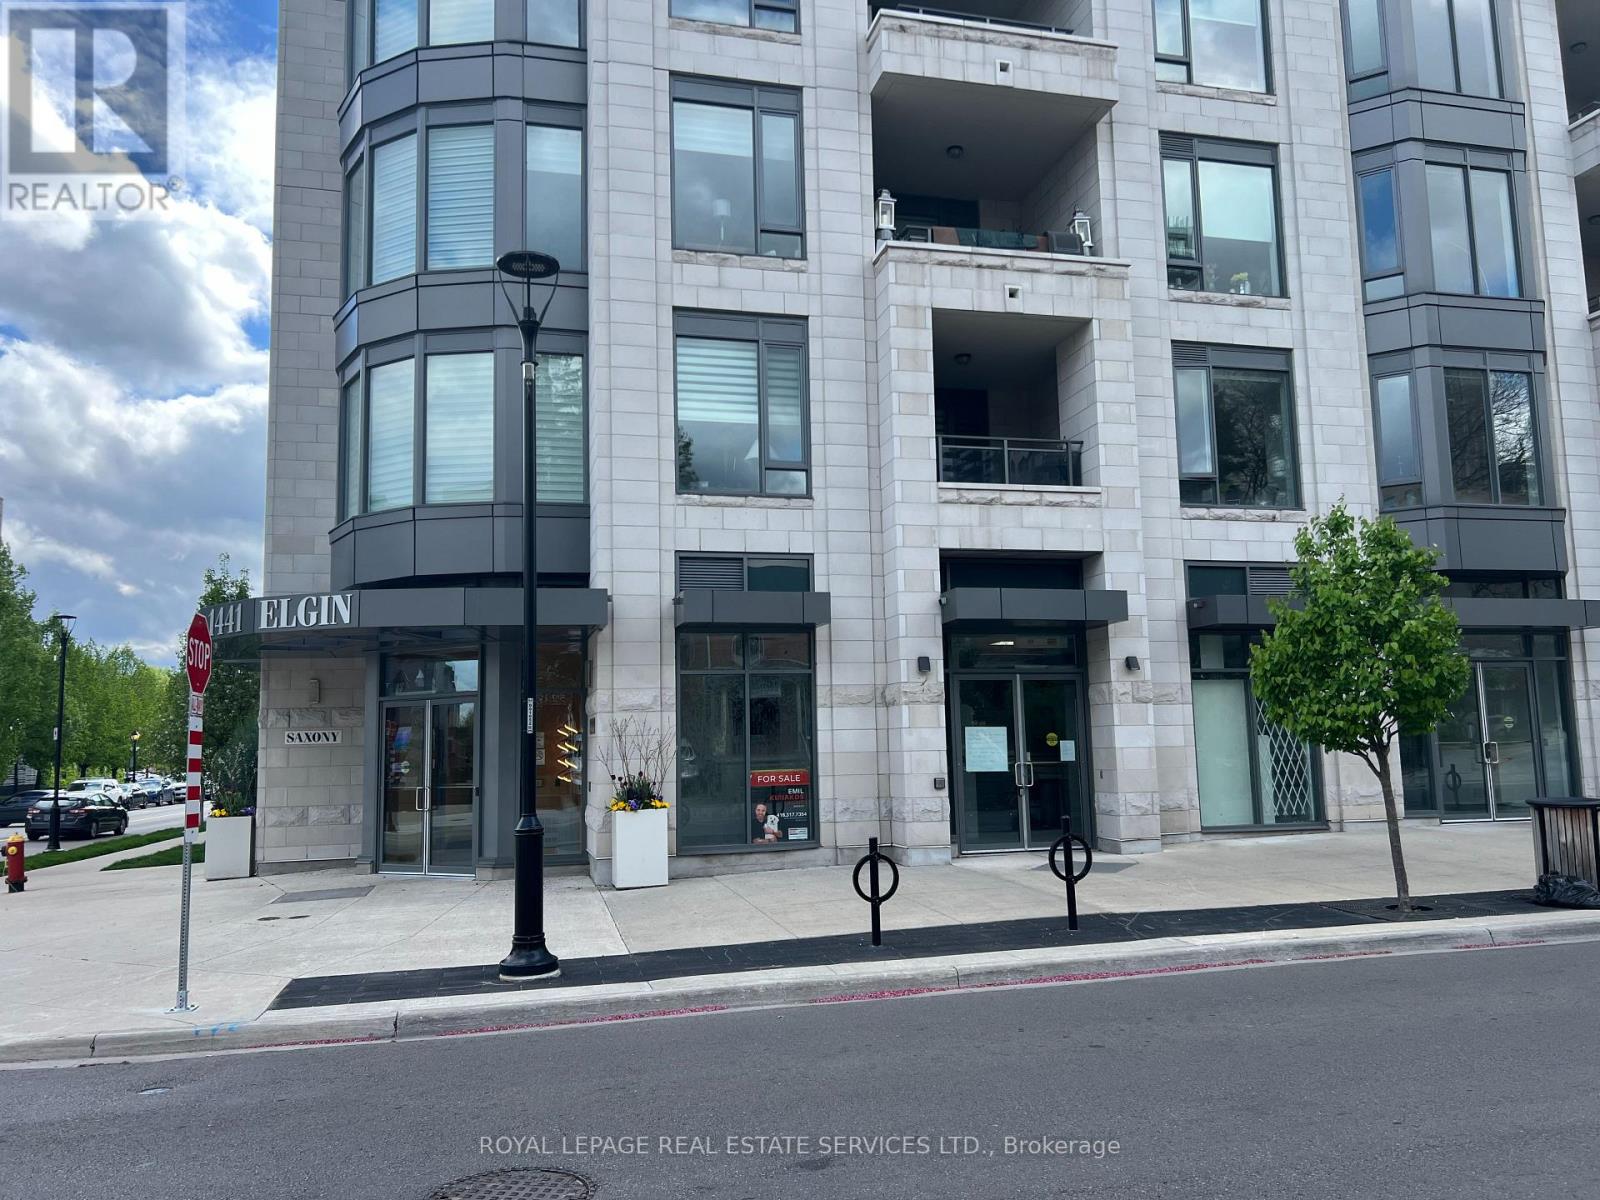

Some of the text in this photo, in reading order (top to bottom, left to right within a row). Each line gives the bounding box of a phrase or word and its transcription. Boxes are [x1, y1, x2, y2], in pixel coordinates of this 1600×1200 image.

[209, 594, 353, 637] 1441 ELGIN
[188, 638, 211, 670] STOP
[286, 731, 340, 744] SAXONY
[757, 774, 801, 783] FOR SALE
